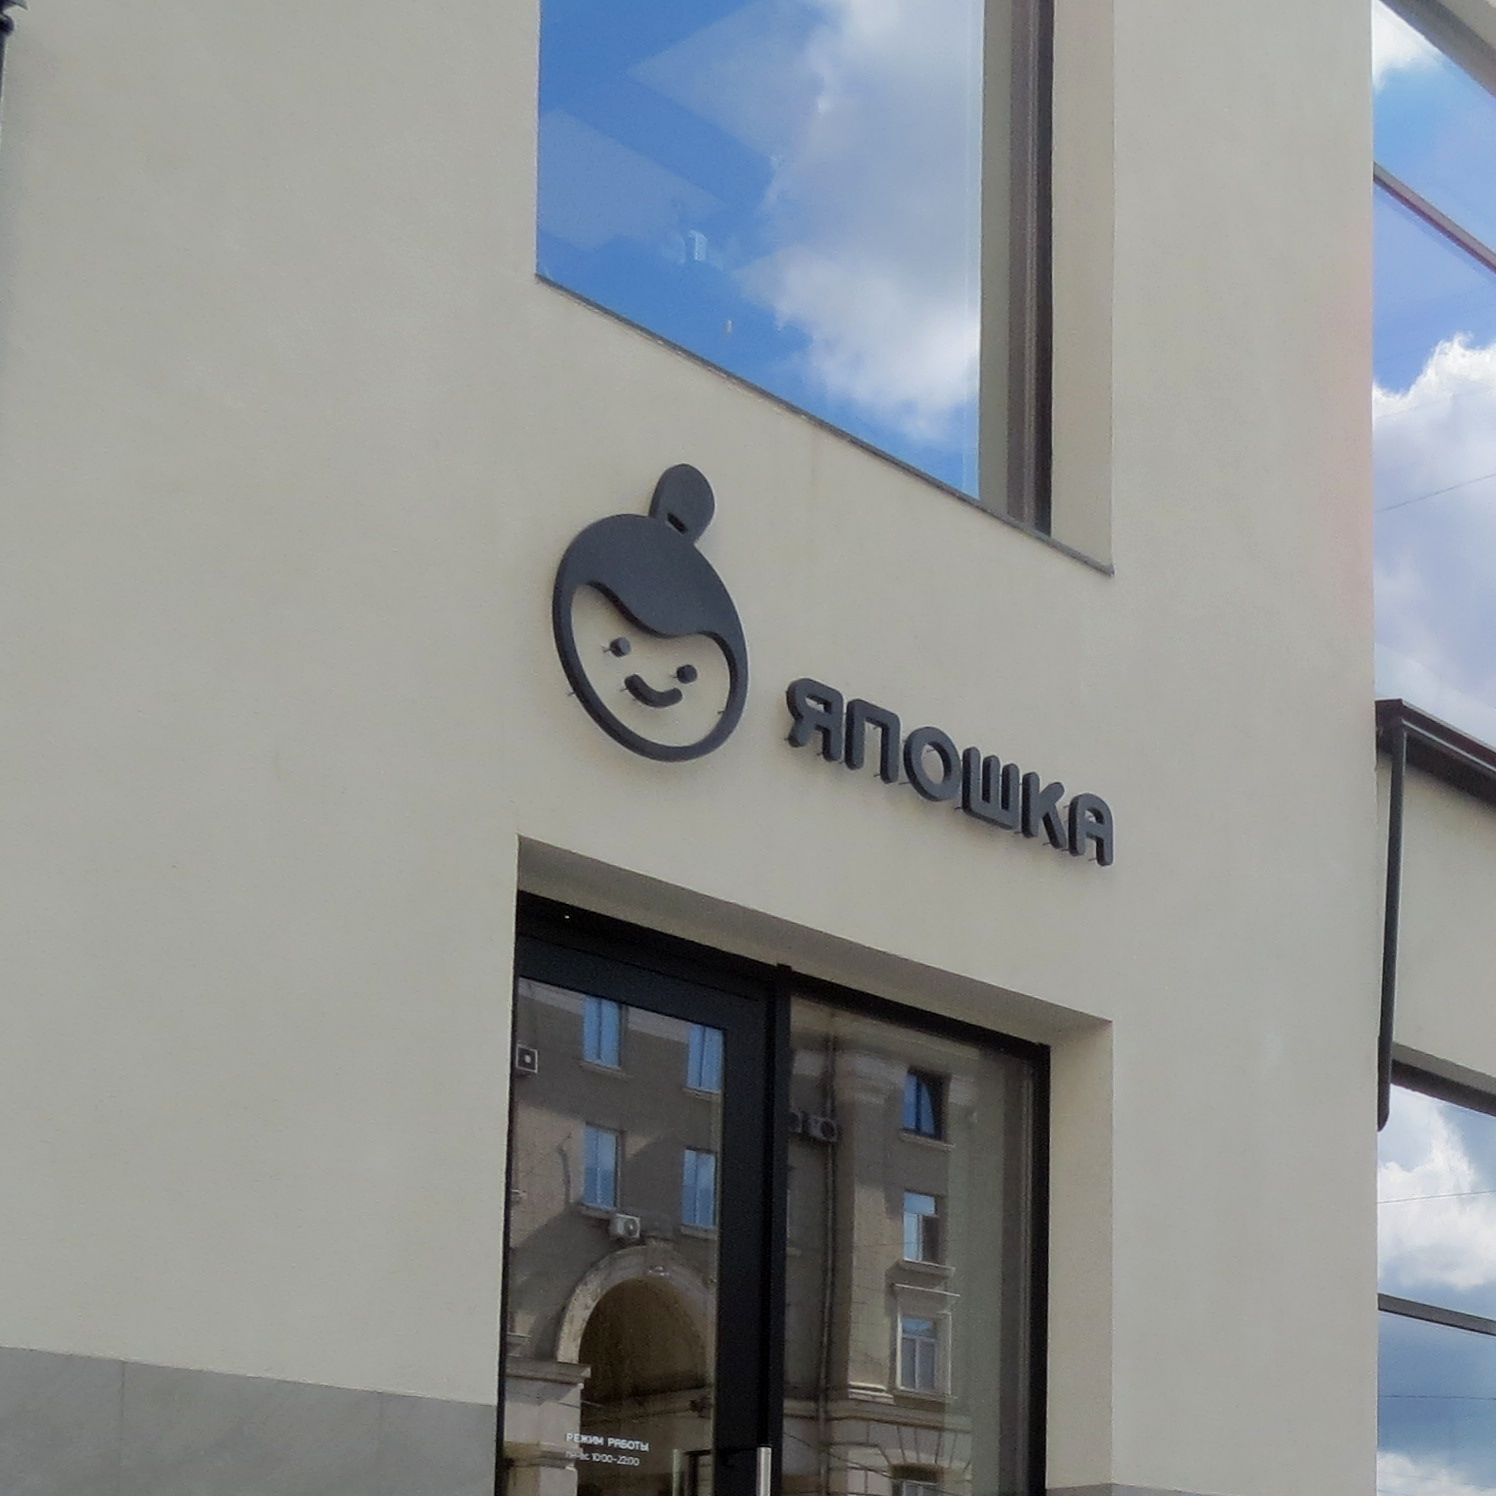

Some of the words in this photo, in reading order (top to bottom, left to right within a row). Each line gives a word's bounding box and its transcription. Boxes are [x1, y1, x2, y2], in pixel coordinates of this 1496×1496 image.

[785, 678, 1114, 866] ЯПОШКА
[567, 1433, 604, 1446] РЕЖИМ
[608, 1438, 649, 1451] РАБОТЫ
